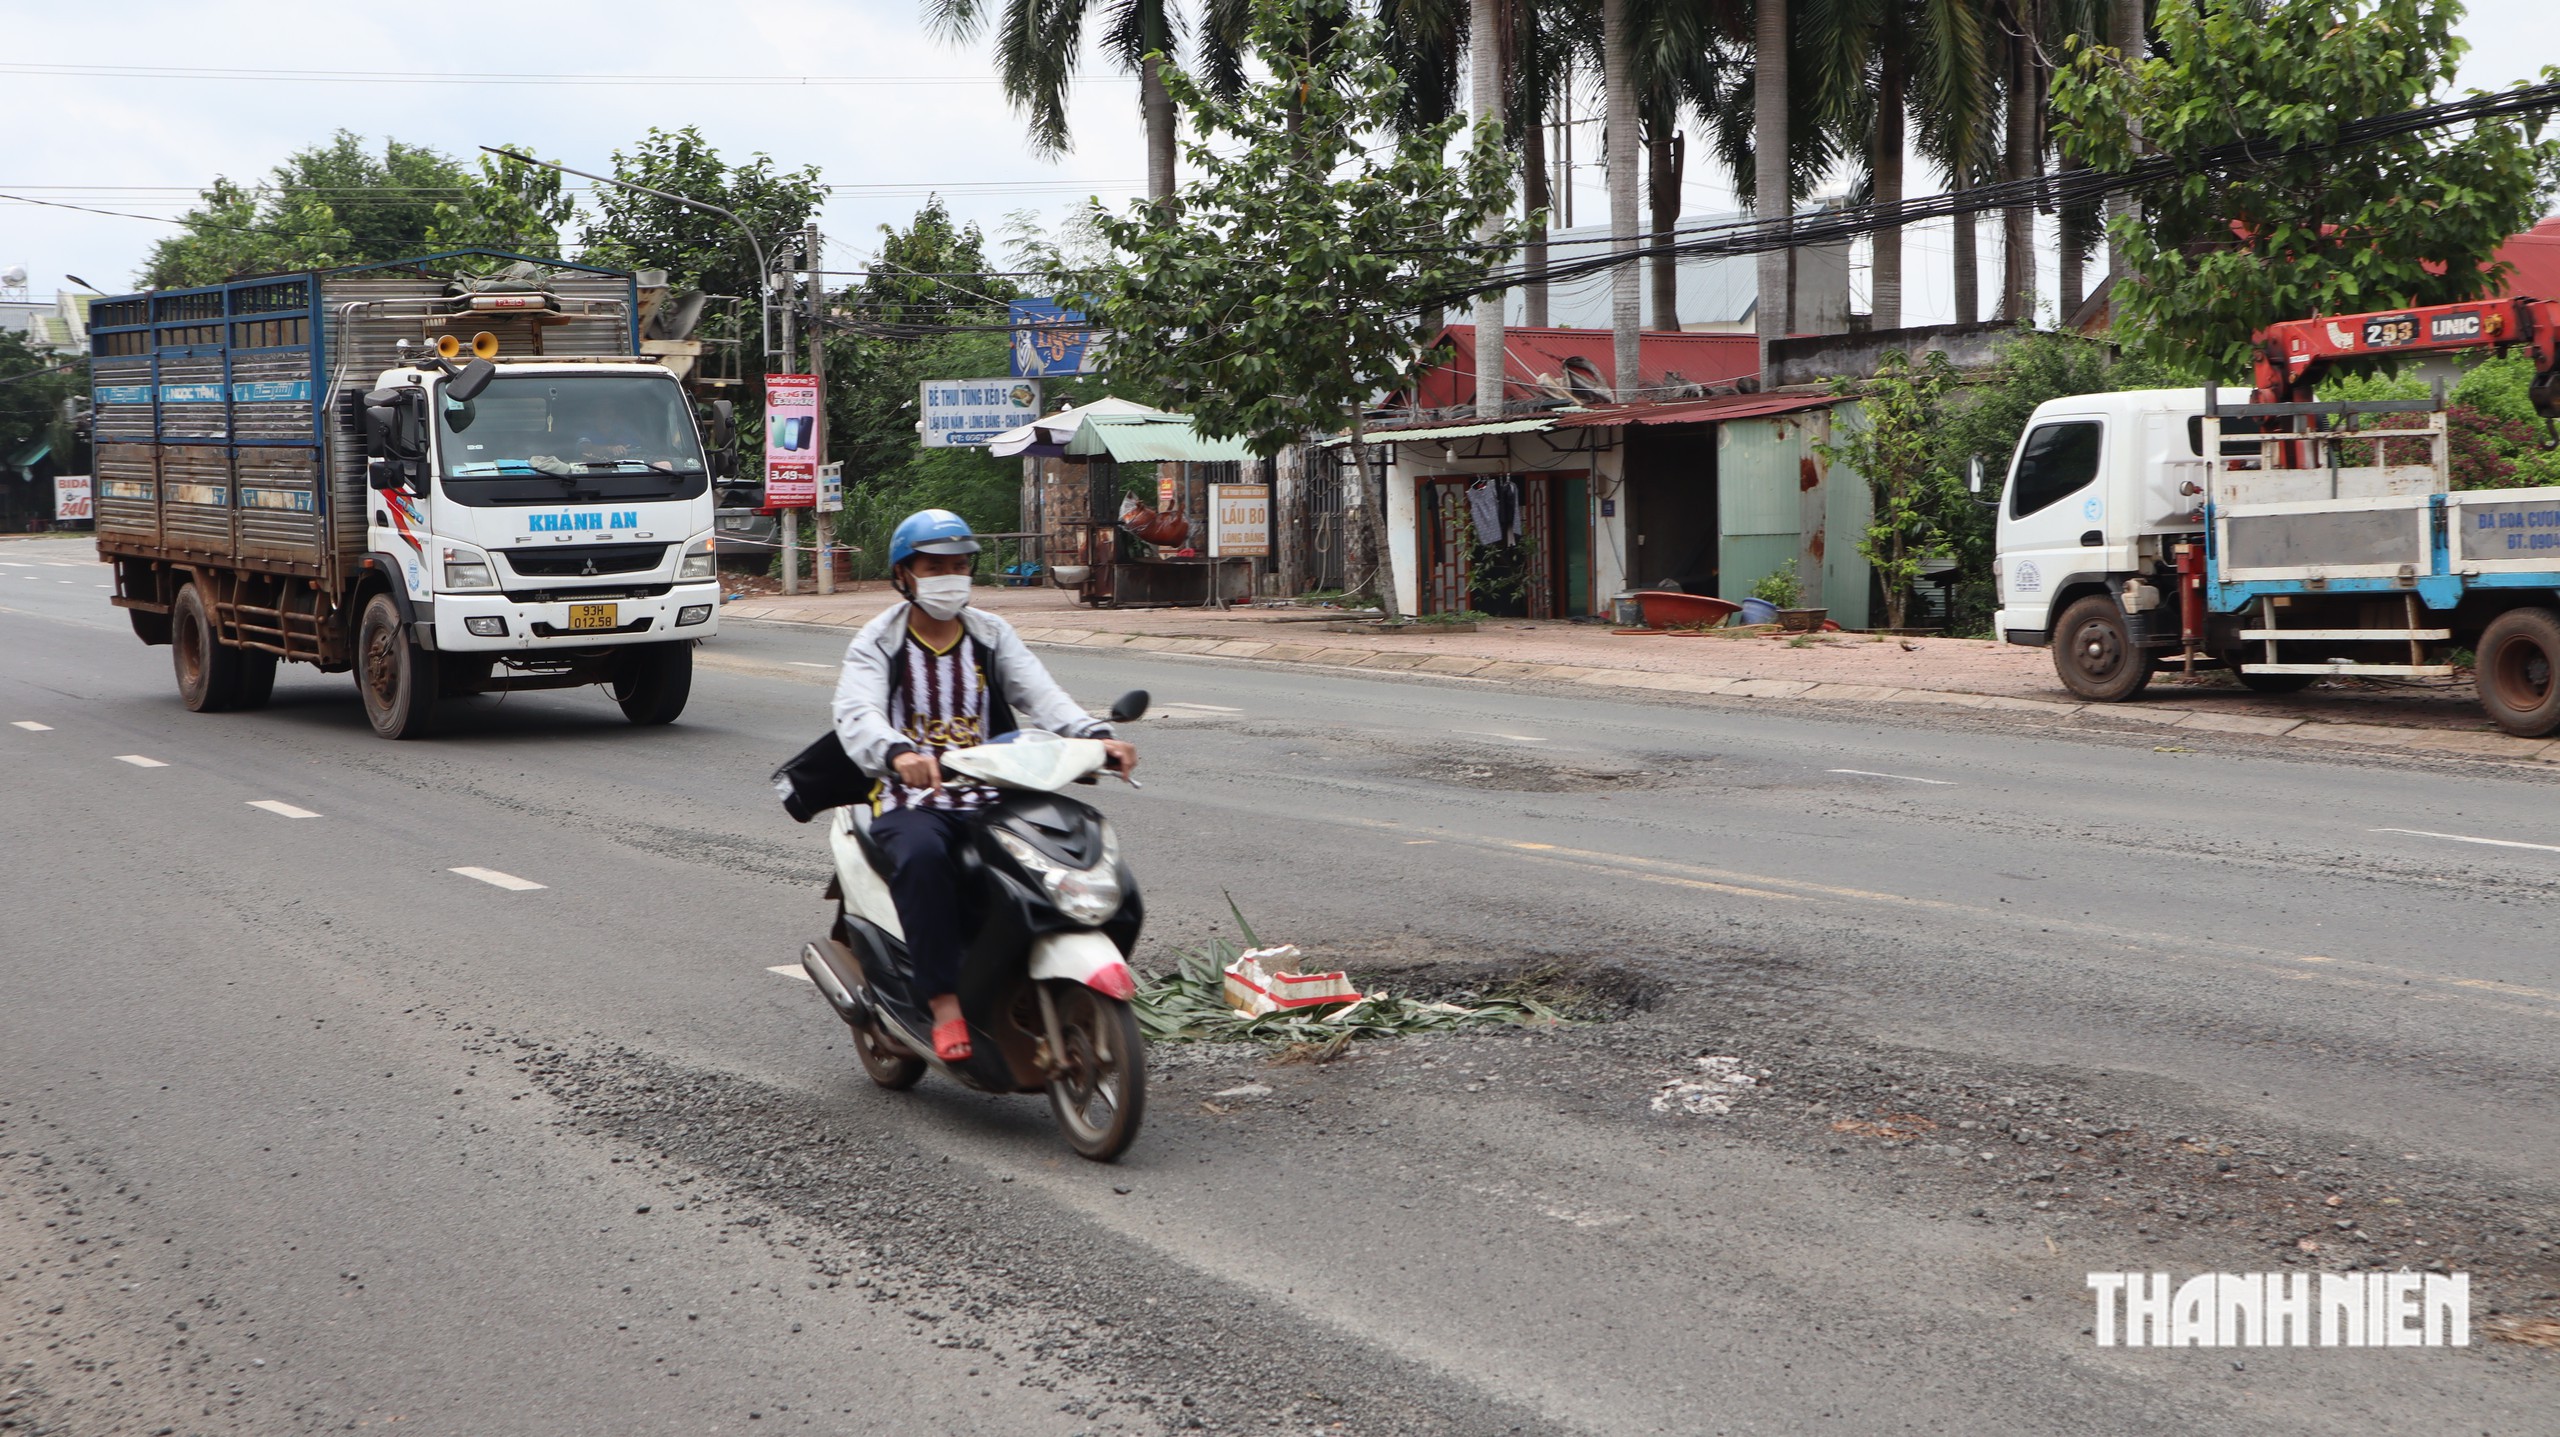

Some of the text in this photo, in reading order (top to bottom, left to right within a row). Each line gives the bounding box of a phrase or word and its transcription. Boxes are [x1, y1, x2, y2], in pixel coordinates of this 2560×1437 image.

[2366, 321, 2413, 344] 293
[2431, 316, 2480, 336] UNIC
[941, 389, 960, 406] THUI
[961, 385, 982, 406] TÙNG
[1001, 388, 1007, 405] 5
[771, 470, 798, 480] 3.49
[58, 479, 89, 489] BIDA
[528, 508, 638, 532] KHÁNH AN
[1222, 501, 1265, 525] LẨU BÒ
[515, 532, 654, 544] FUSO
[583, 605, 604, 617] 93H
[574, 617, 612, 628] 012.58
